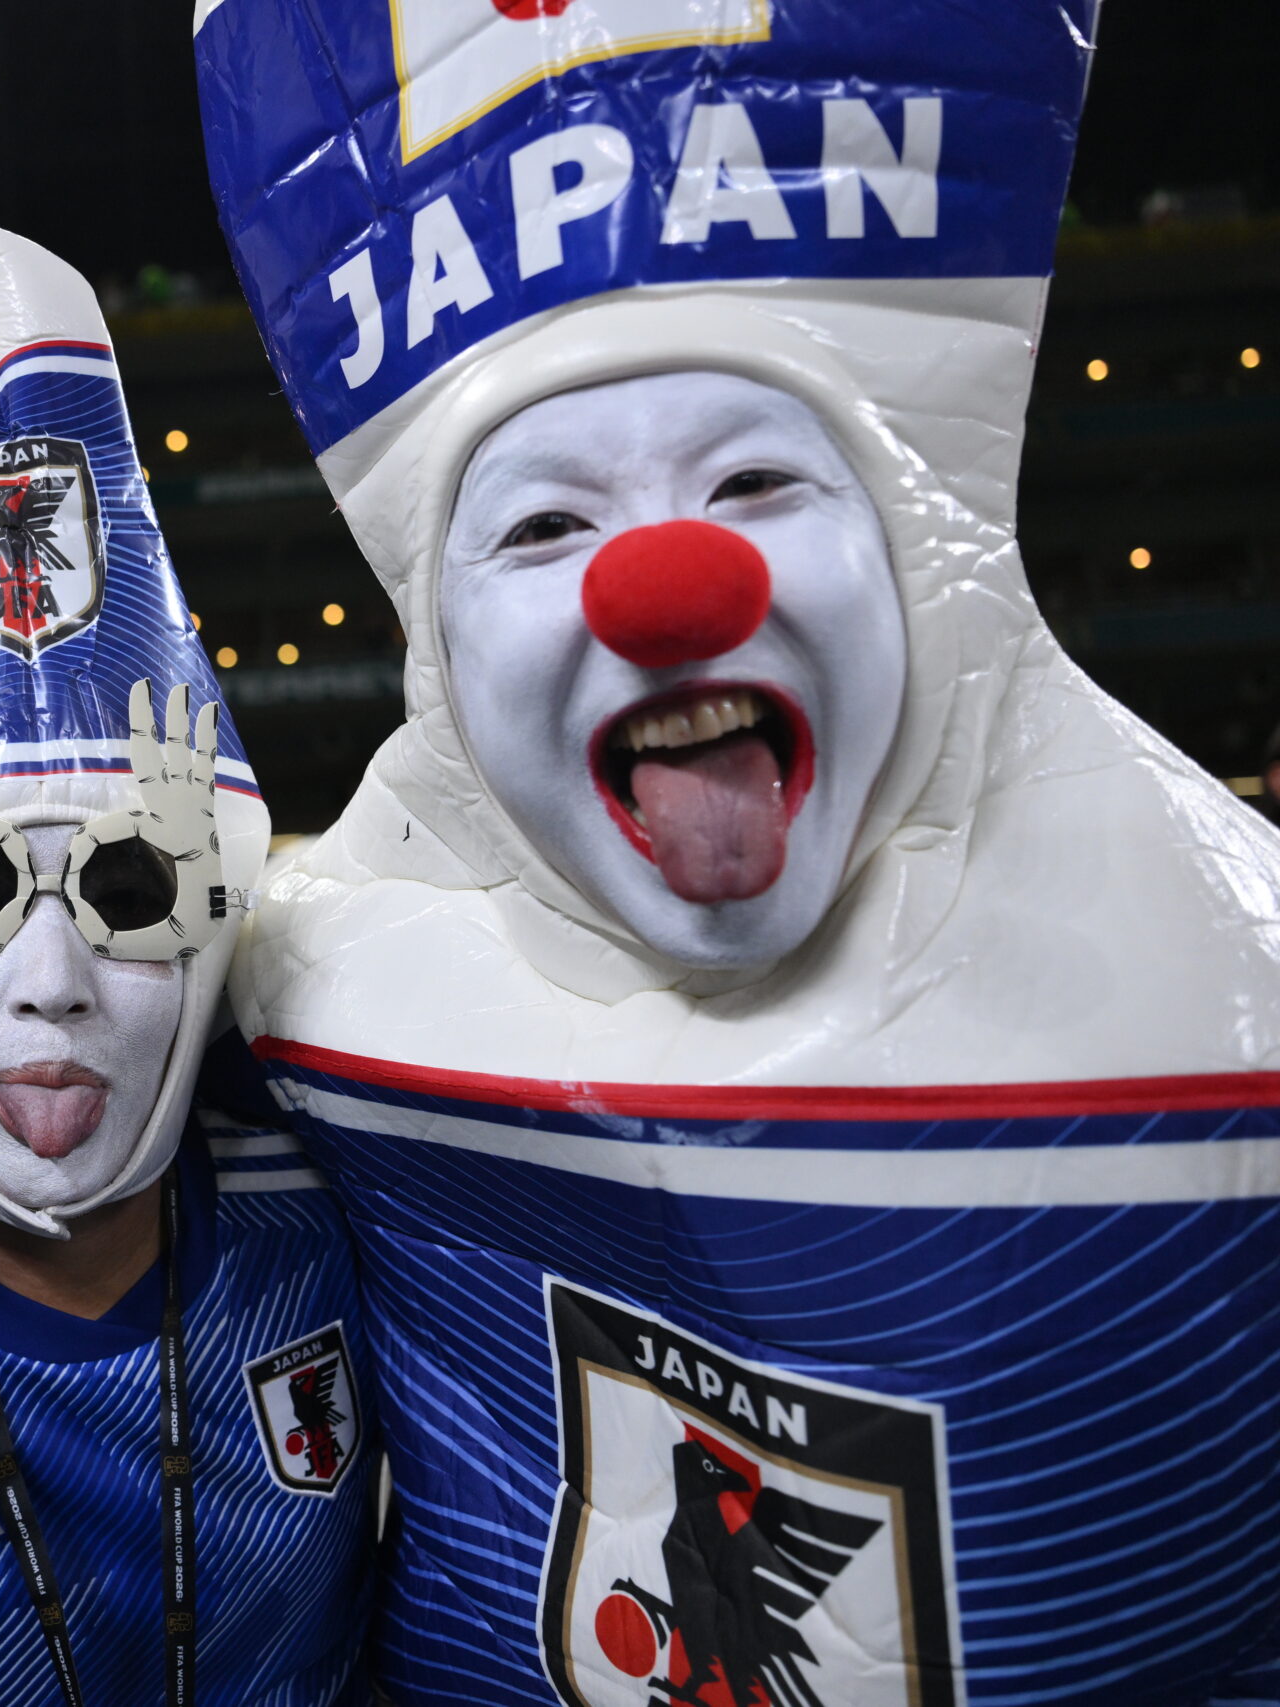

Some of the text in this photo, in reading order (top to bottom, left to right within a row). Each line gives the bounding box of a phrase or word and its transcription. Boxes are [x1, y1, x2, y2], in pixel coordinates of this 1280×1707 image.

[328, 97, 944, 390] JAPAN
[273, 1341, 323, 1373] JAPAN
[168, 1358, 177, 1390] WORLD
[170, 1391, 178, 1410] CUP
[634, 1334, 808, 1447] JAPAN
[174, 1487, 182, 1507] FIFA
[17, 1521, 29, 1539] CUP
[174, 1509, 183, 1544] WORLD
[24, 1540, 40, 1573] WORLD
[175, 1545, 183, 1564] CUP
[35, 1574, 46, 1595] FIFA
[64, 1672, 73, 1692] CUP
